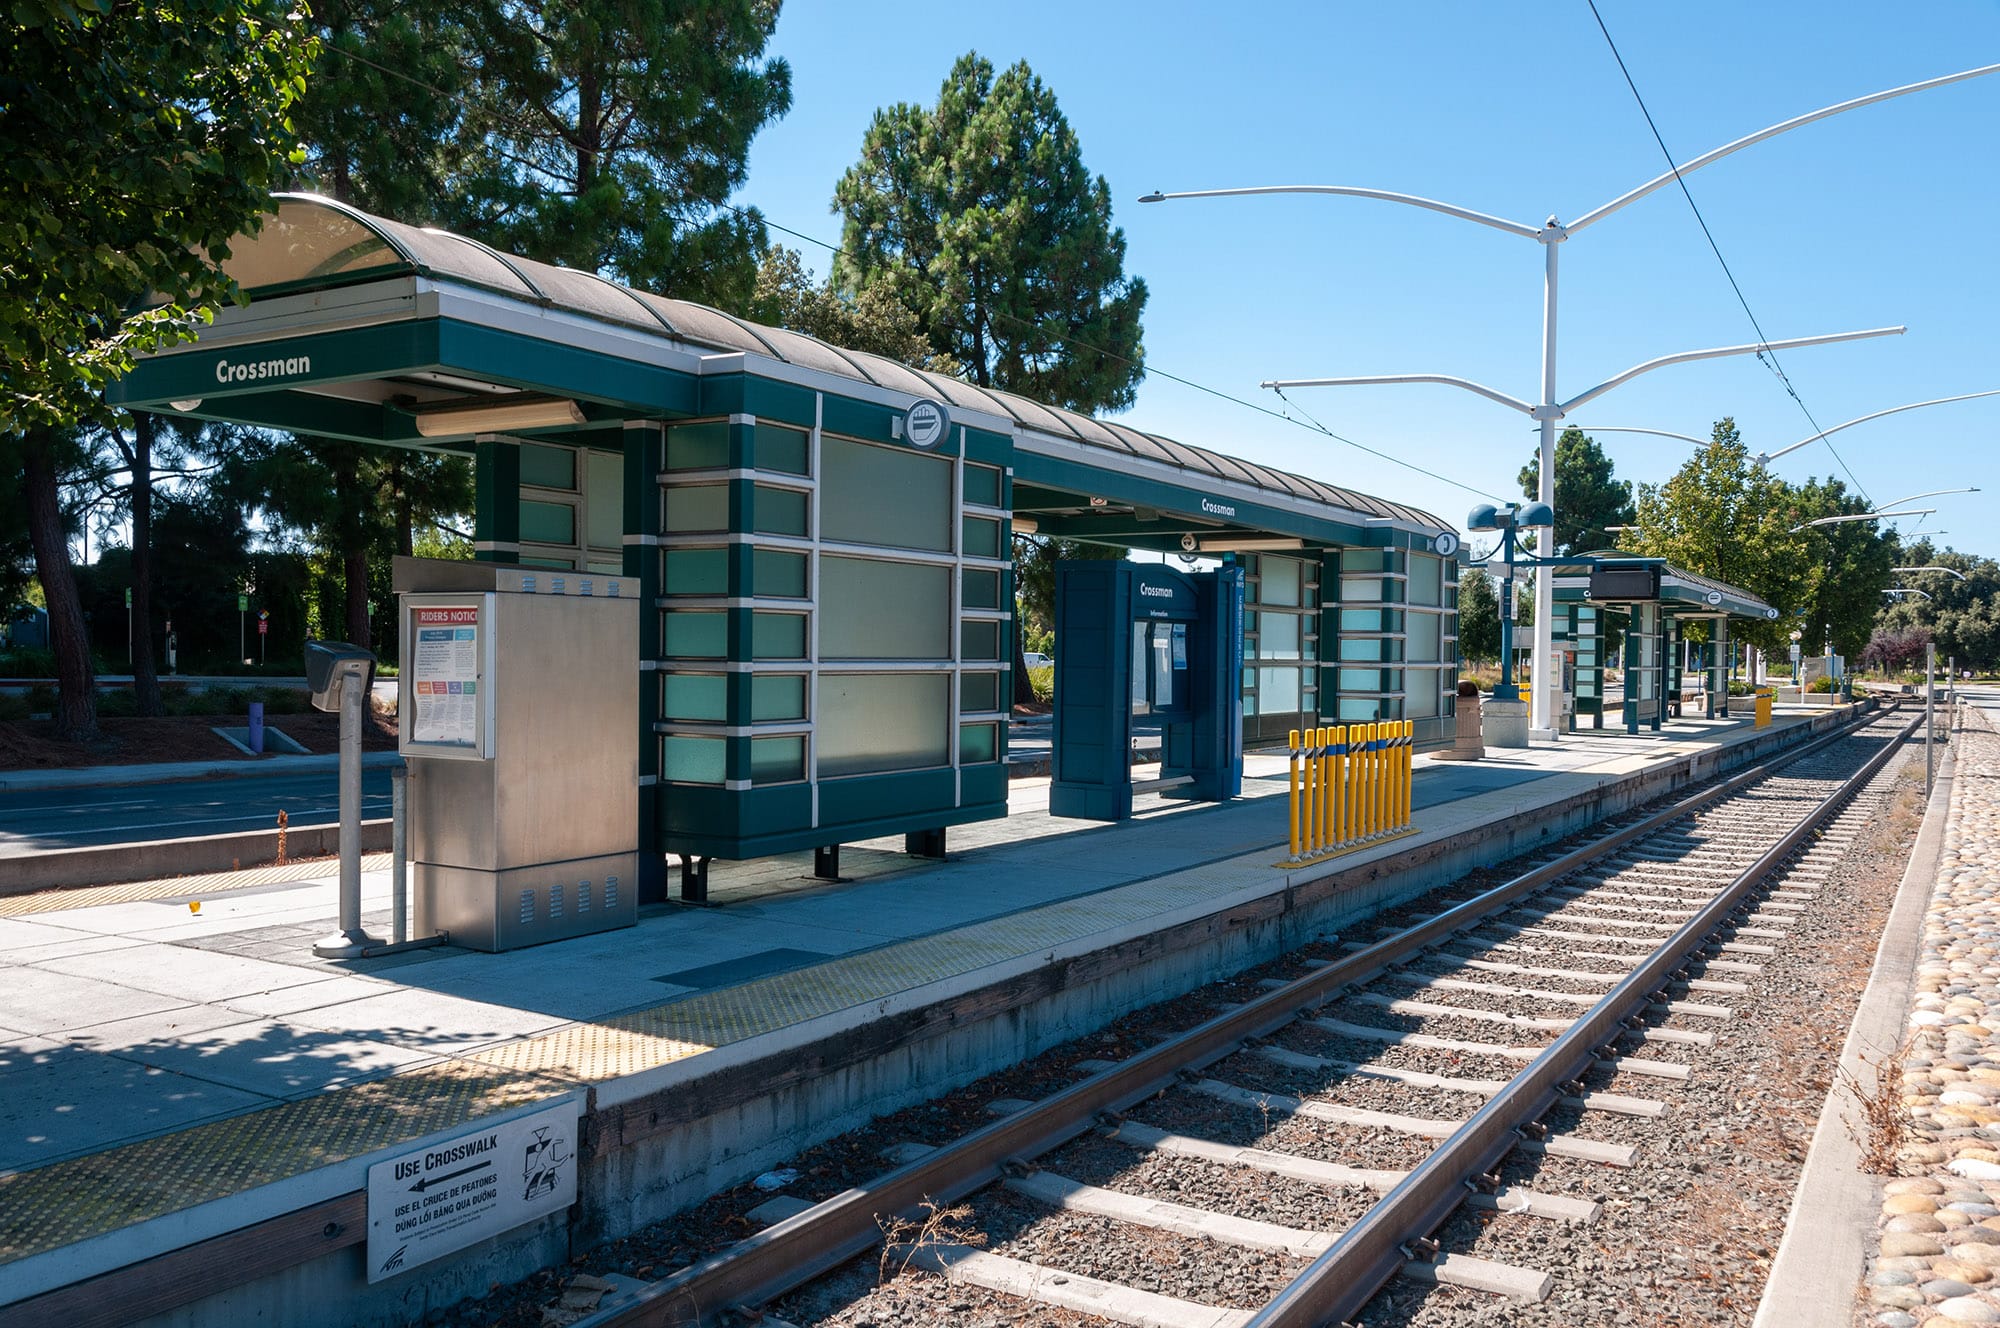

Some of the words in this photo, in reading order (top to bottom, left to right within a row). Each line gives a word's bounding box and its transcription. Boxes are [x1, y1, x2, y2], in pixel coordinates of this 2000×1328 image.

[216, 356, 310, 383] Crossman
[1201, 498, 1235, 516] Crossman
[1140, 582, 1173, 598] Crossman
[421, 611, 449, 621] RIDERS
[395, 1160, 420, 1180] USE
[425, 1135, 497, 1171] CROSSWALK
[395, 1204, 410, 1217] USE
[412, 1201, 421, 1211] EL
[423, 1191, 448, 1207] CRUCE
[450, 1187, 459, 1198] DE
[461, 1173, 497, 1194] PEATONES
[456, 1198, 471, 1211] QUA
